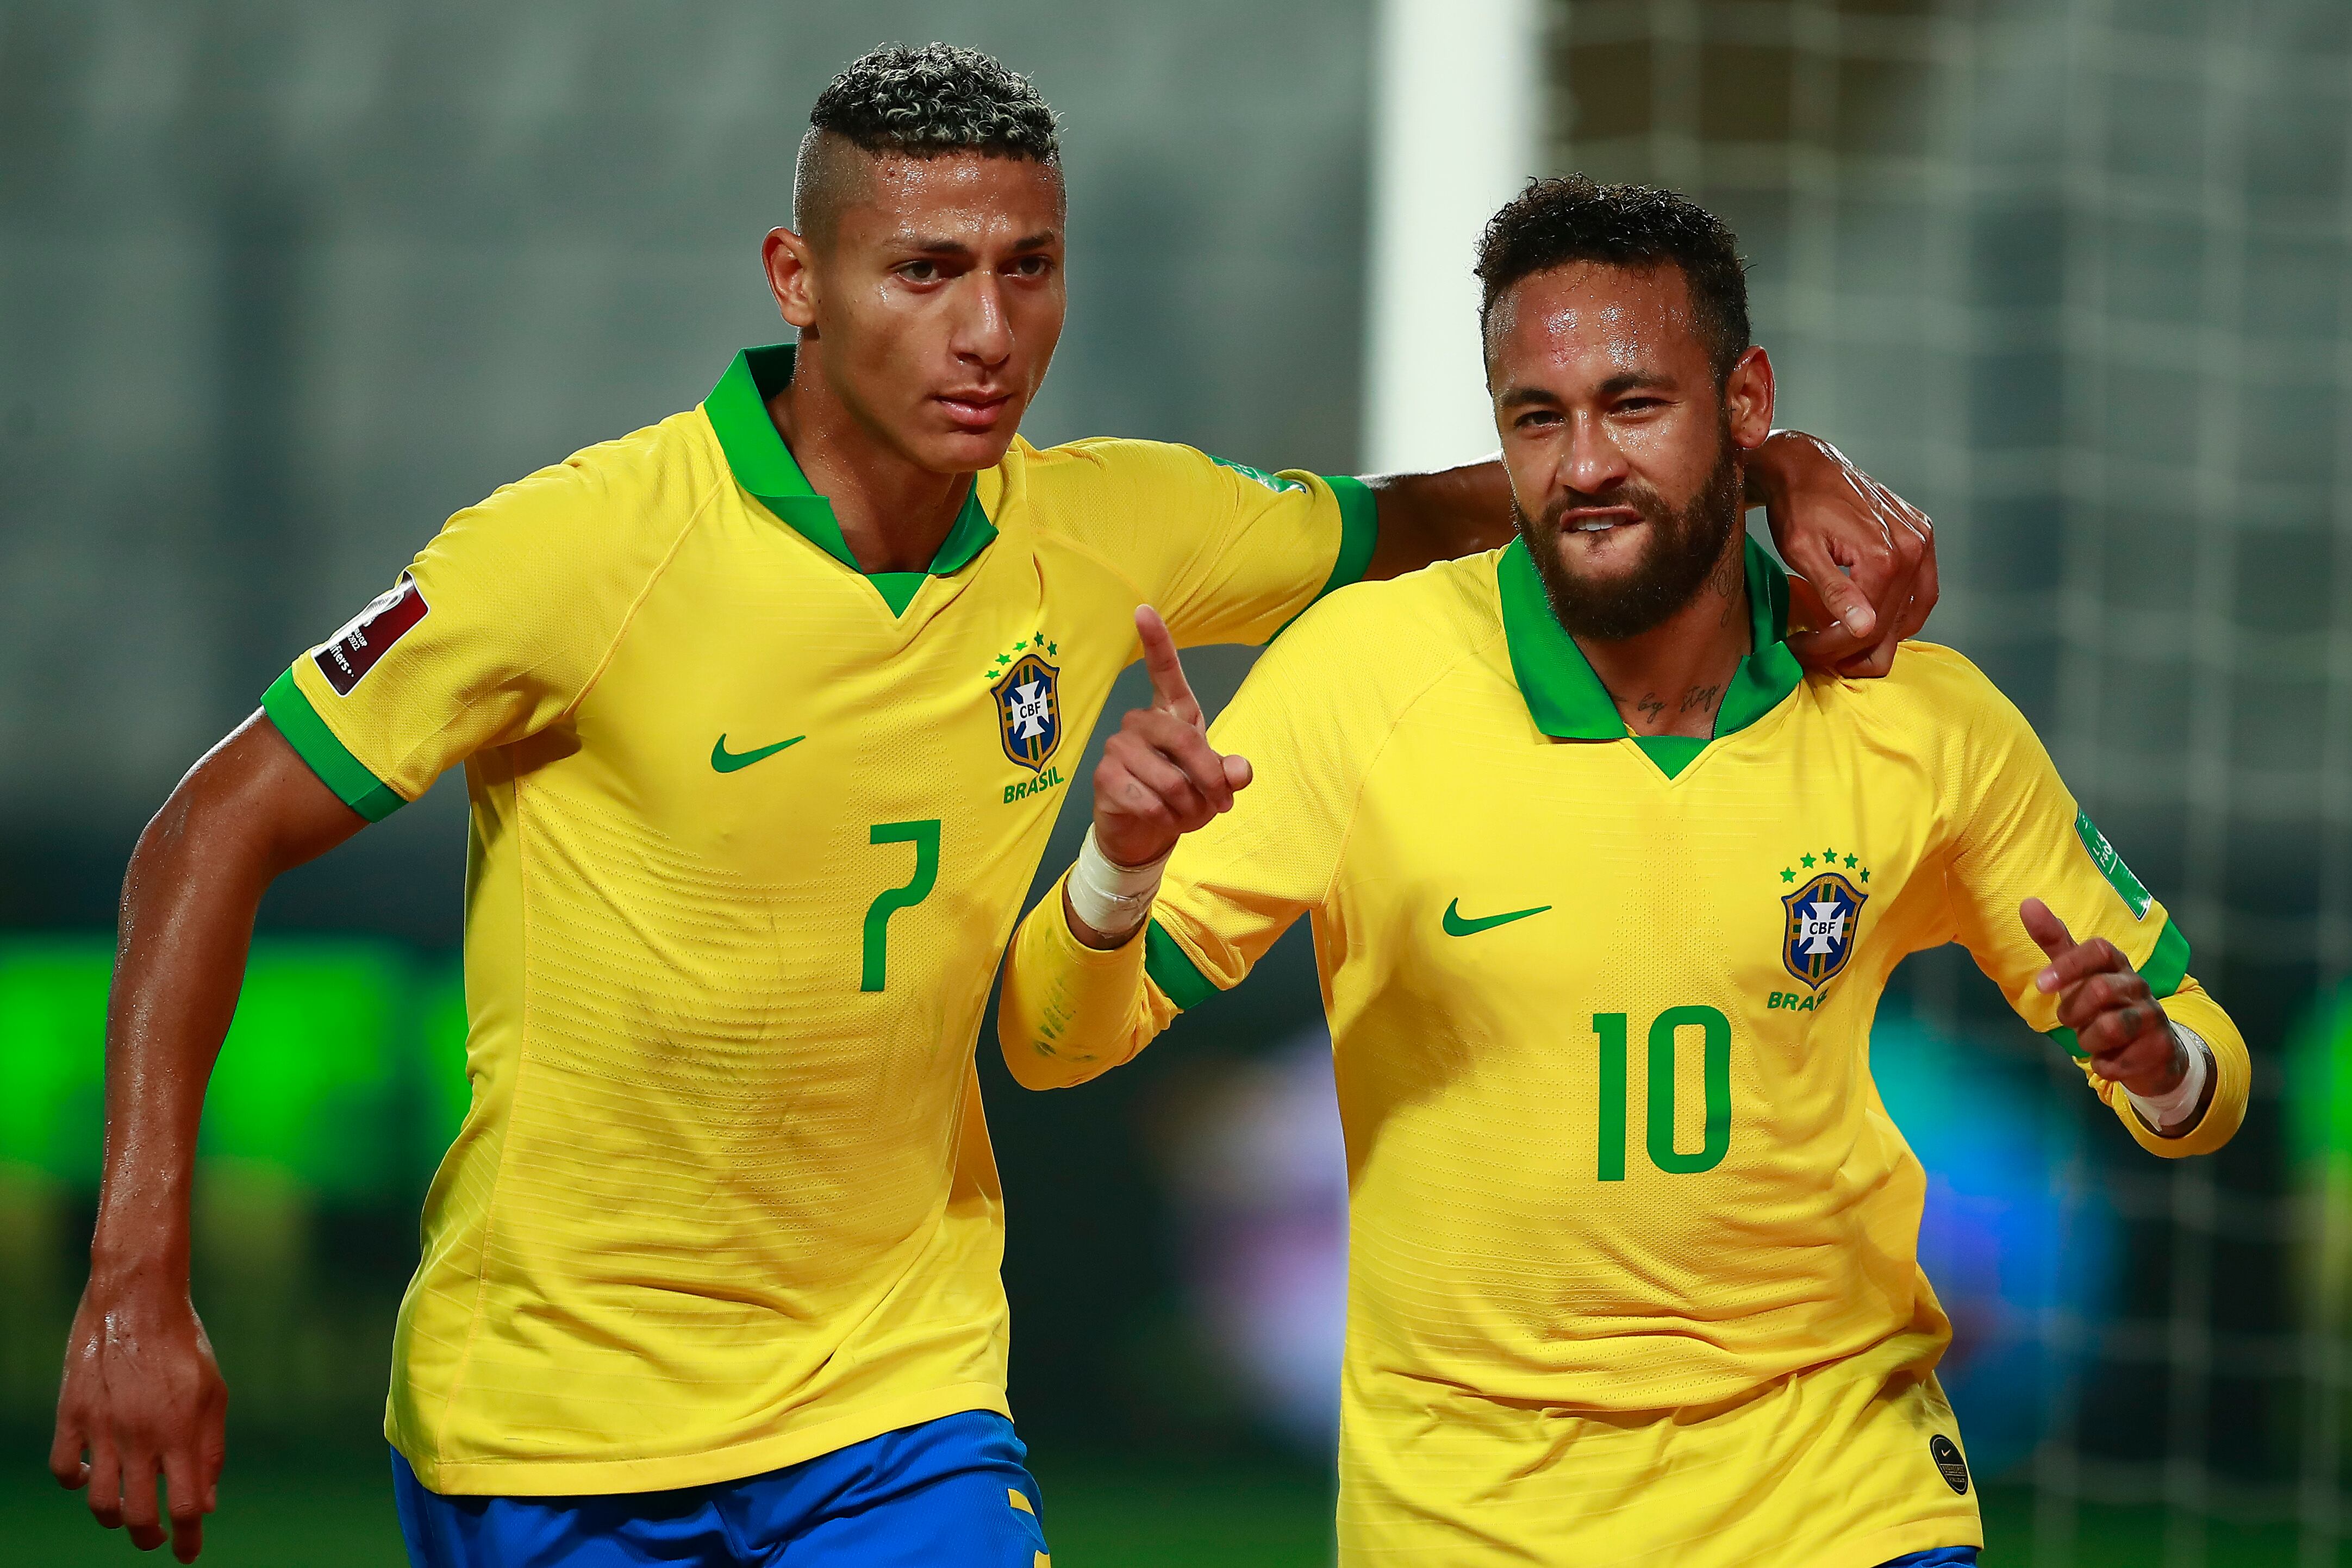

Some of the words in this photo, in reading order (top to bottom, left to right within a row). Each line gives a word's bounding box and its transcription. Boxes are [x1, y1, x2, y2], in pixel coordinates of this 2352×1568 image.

[329, 643, 350, 671] ifiers
[1020, 701, 1041, 719] CBF
[1003, 766, 1064, 804] BRASIL
[860, 819, 941, 992] 7
[1809, 922, 1836, 935] CBF
[1592, 1005, 1732, 1182] 10
